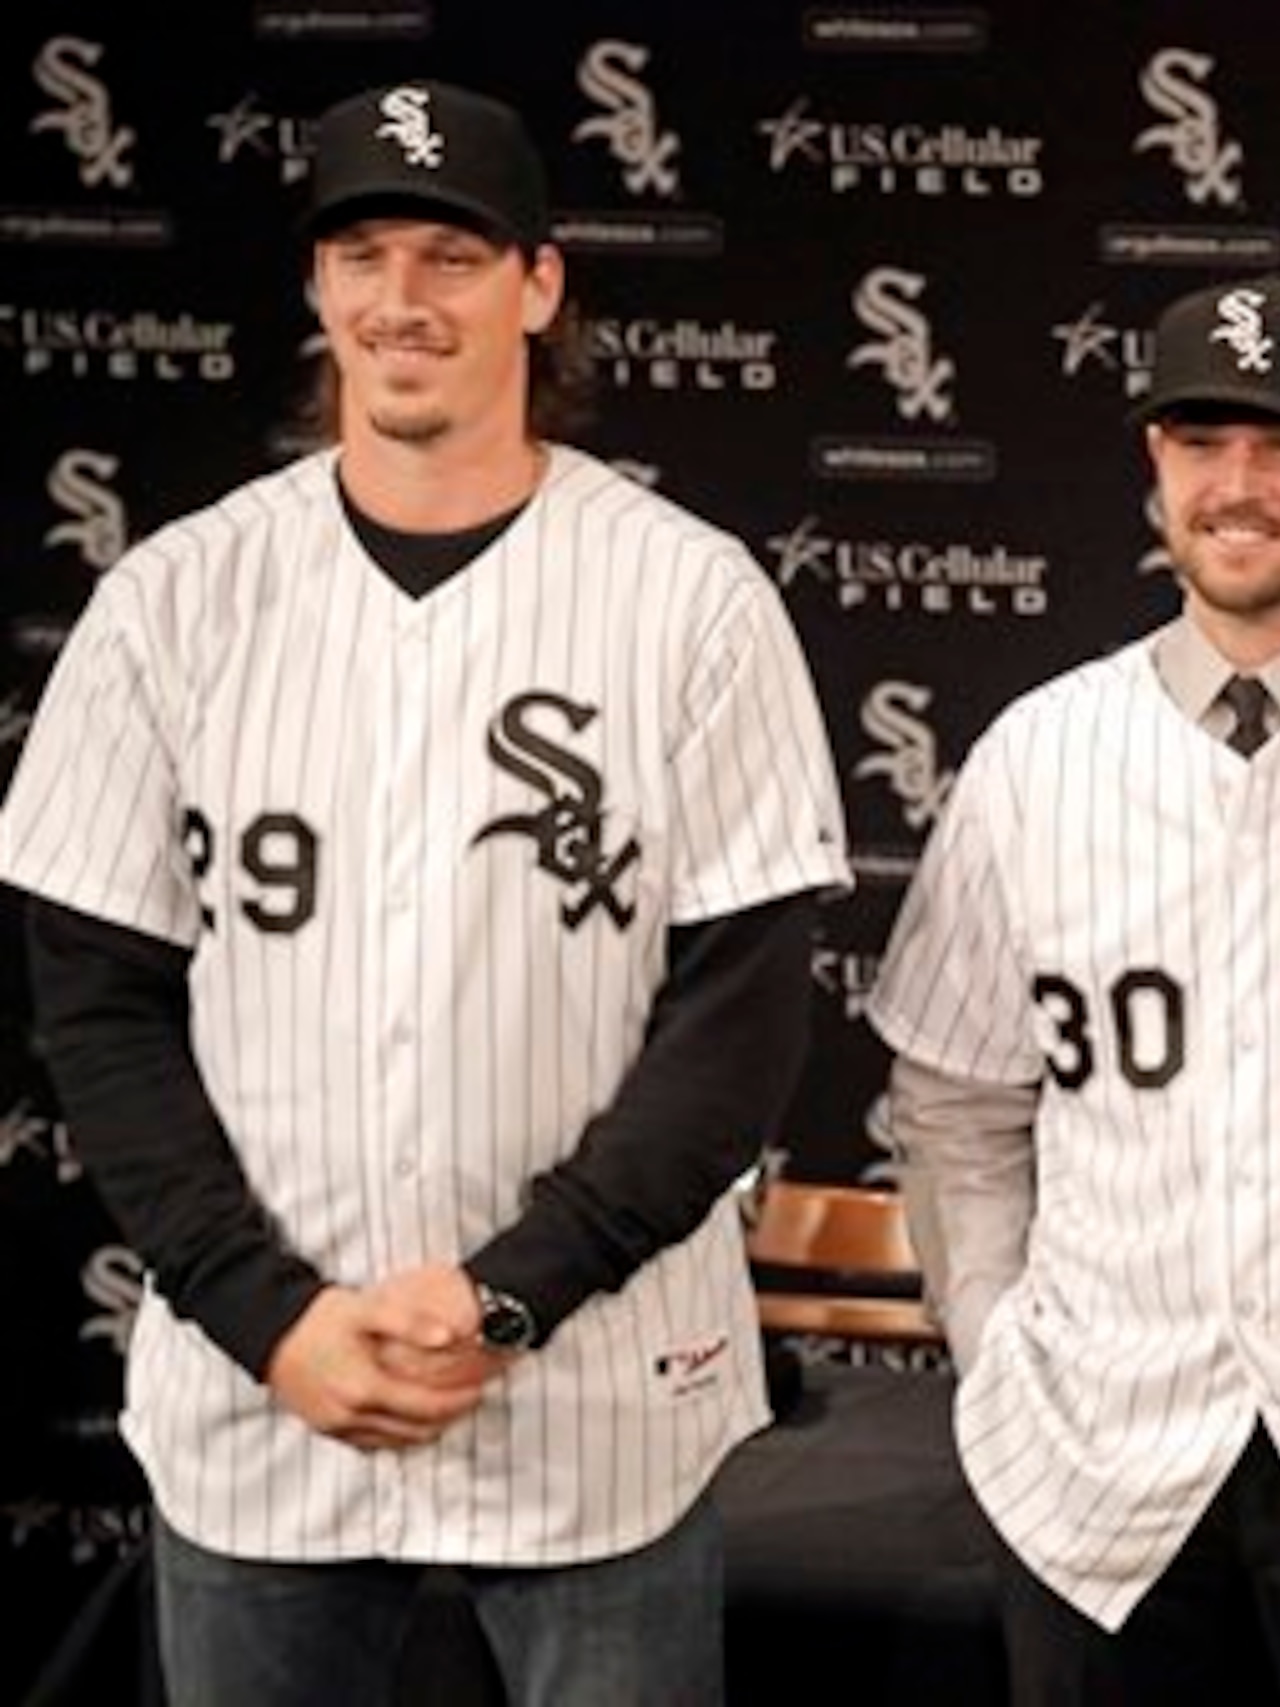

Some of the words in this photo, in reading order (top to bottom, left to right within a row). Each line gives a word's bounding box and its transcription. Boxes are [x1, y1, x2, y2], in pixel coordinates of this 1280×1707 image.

[891, 126, 1041, 165] Cellular
[832, 167, 1042, 195] FIELD
[84, 314, 232, 350] Cellular
[626, 321, 775, 360] Cellular
[25, 350, 234, 379] FIELD
[615, 360, 775, 389] IELD
[46, 450, 126, 567] So
[898, 546, 1046, 586] Cellular
[840, 586, 1047, 614] FIELD
[469, 690, 641, 933] Sox
[1030, 968, 1186, 1090] 30
